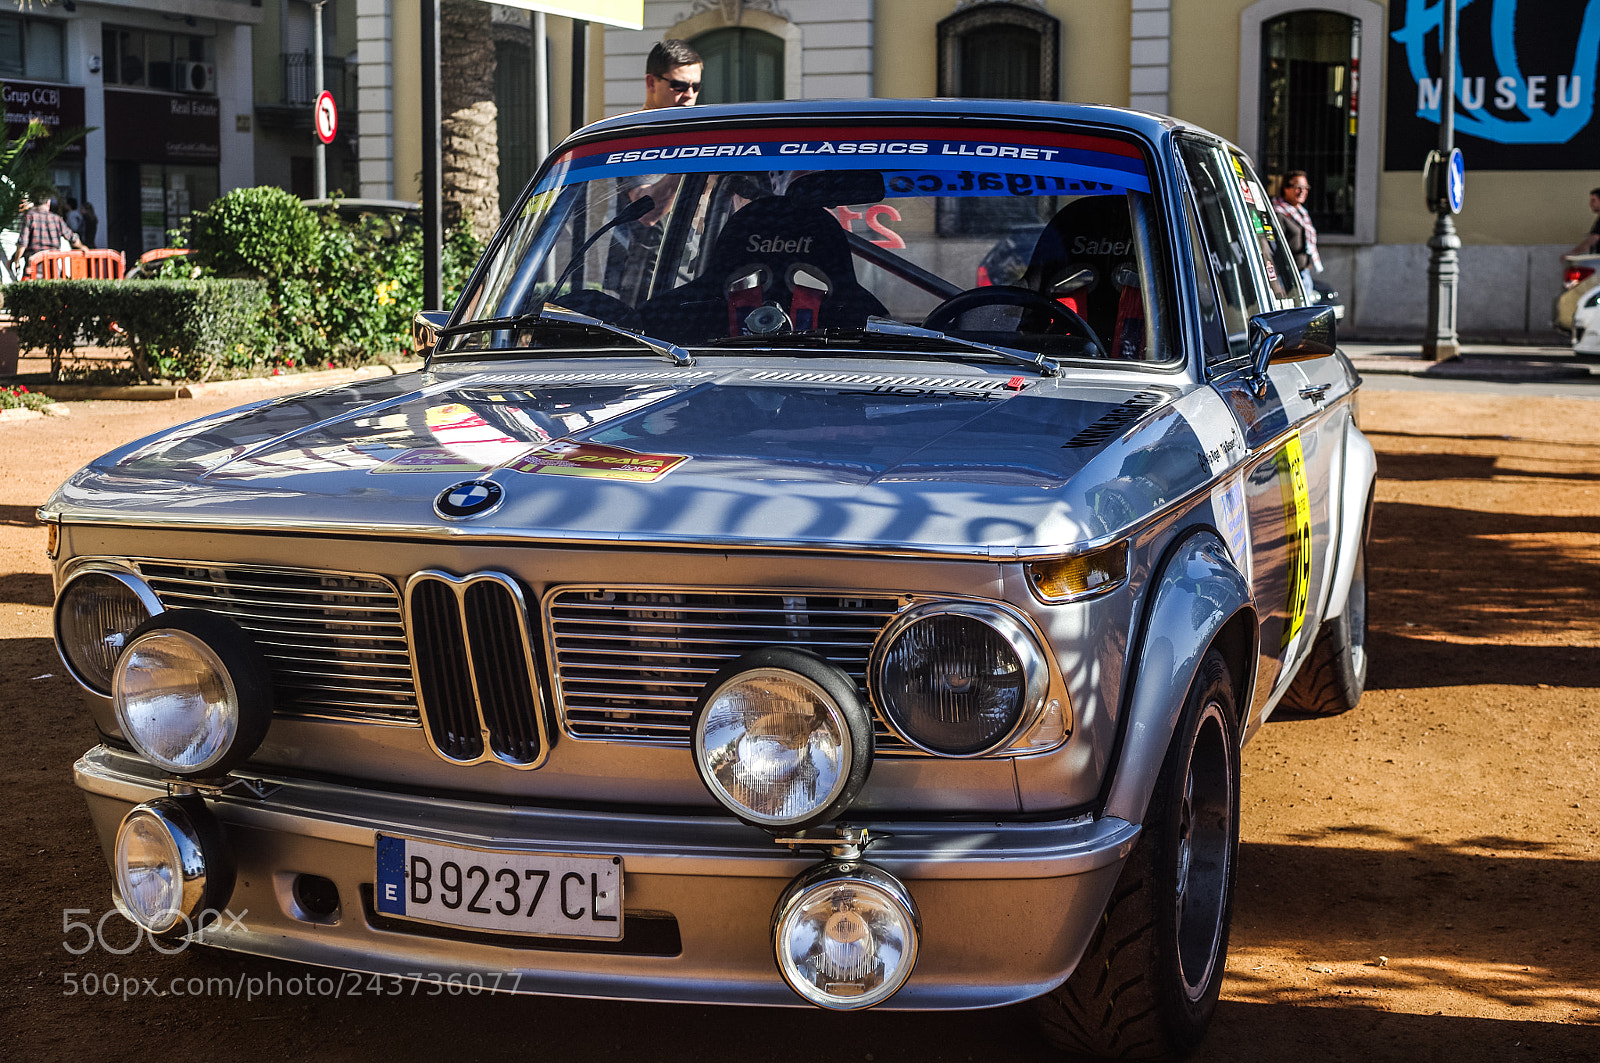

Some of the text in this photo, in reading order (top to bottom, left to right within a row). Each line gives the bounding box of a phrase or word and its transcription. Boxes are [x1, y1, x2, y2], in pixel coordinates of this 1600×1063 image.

[2, 86, 30, 107] Grup
[1418, 75, 1581, 110] MUSEU
[606, 142, 1058, 165] ESCUDERIA CLÀSSICS LLORET
[746, 234, 813, 254] Sabelt
[1071, 236, 1133, 256] Sabel
[870, 385, 1003, 400] lloret
[568, 455, 664, 466] BRAVA
[385, 883, 398, 901] E
